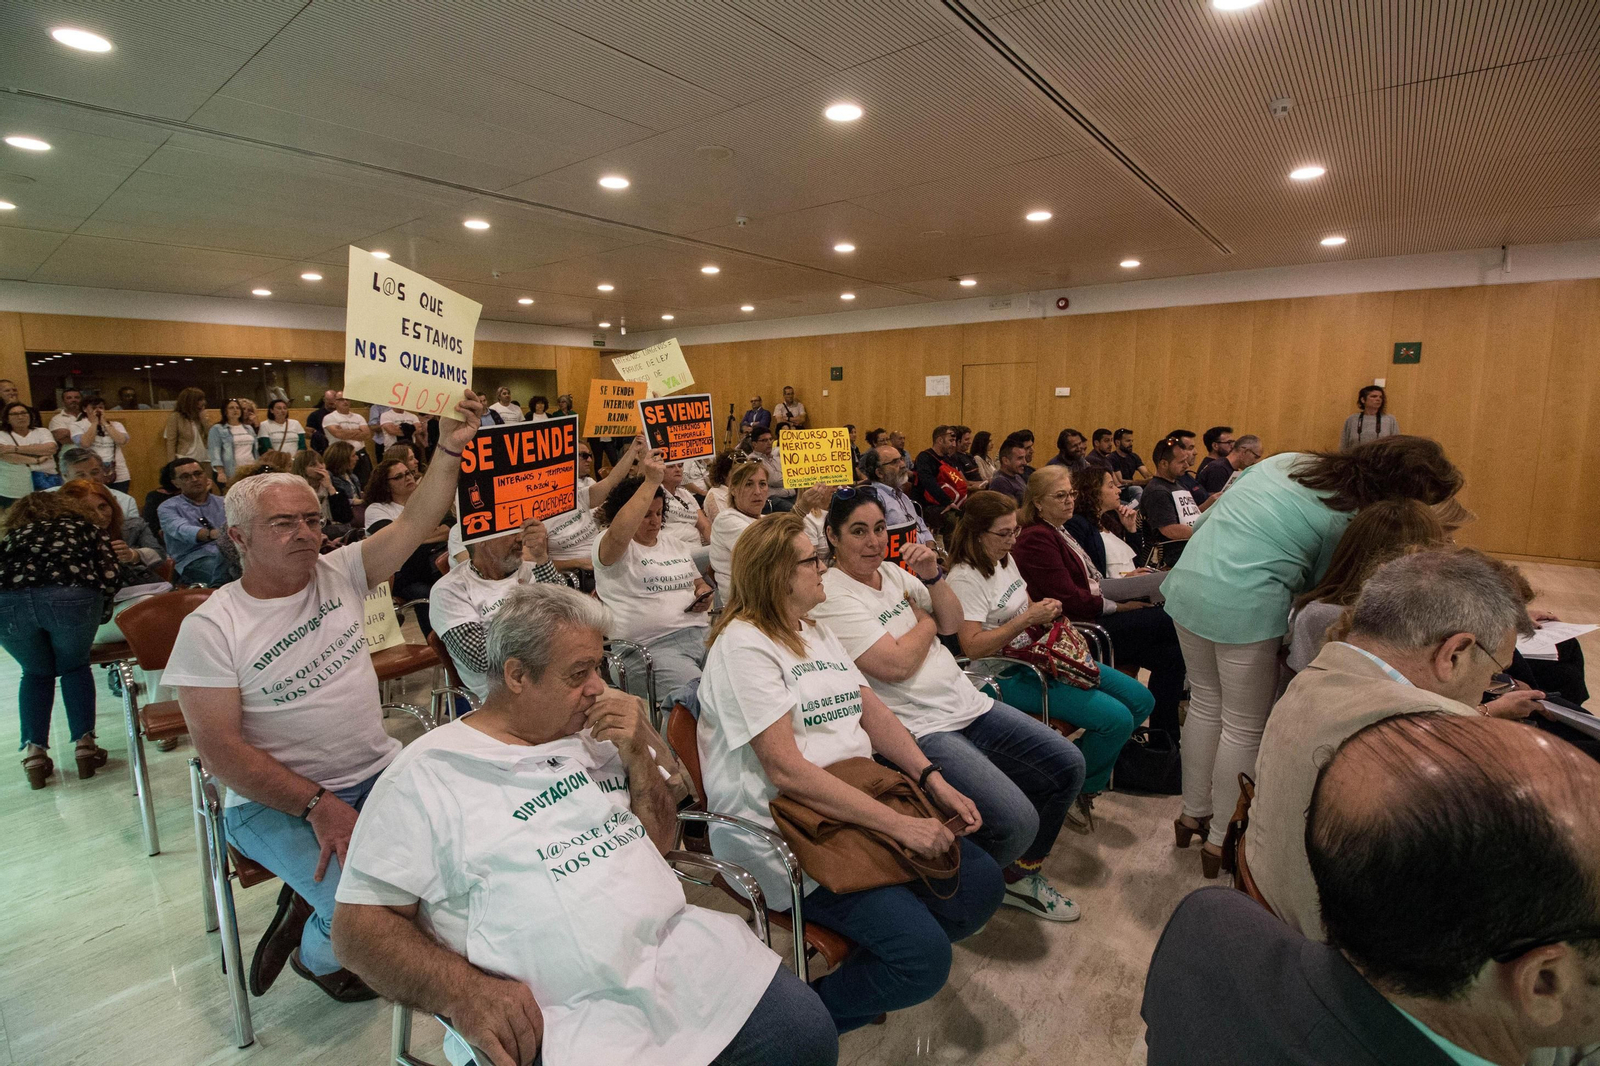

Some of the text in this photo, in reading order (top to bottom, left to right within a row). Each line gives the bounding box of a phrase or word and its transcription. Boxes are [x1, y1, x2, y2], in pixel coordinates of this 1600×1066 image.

[373, 272, 444, 317] L@S QUE
[402, 317, 462, 354] ESTAMOS
[354, 338, 467, 385] NOS QUEDAMOS
[646, 359, 655, 367] DE
[656, 353, 669, 363] LEY
[416, 389, 428, 410] O
[600, 386, 634, 396] SE VENDEN
[603, 400, 634, 409] INTERINOS
[644, 401, 710, 425] SE VENDE
[674, 430, 705, 439] TEMPORALES
[782, 431, 827, 440] CONCURSO
[461, 424, 574, 474] SE VENDE
[682, 447, 703, 456] SEVILLA
[782, 440, 821, 450] MÉRITOS
[783, 453, 799, 465] NO
[804, 454, 809, 463] A
[831, 451, 851, 461] ERES
[787, 464, 847, 477] ENCUBIERTOS
[261, 620, 360, 695] L@S QUE EST@MOS
[272, 634, 366, 706] NOS QUEDAMOS
[801, 700, 820, 712] L@S
[821, 697, 833, 706] QUE
[513, 771, 589, 822] DIPUTACION
[570, 827, 603, 846] QUE
[550, 851, 590, 882] NOS
